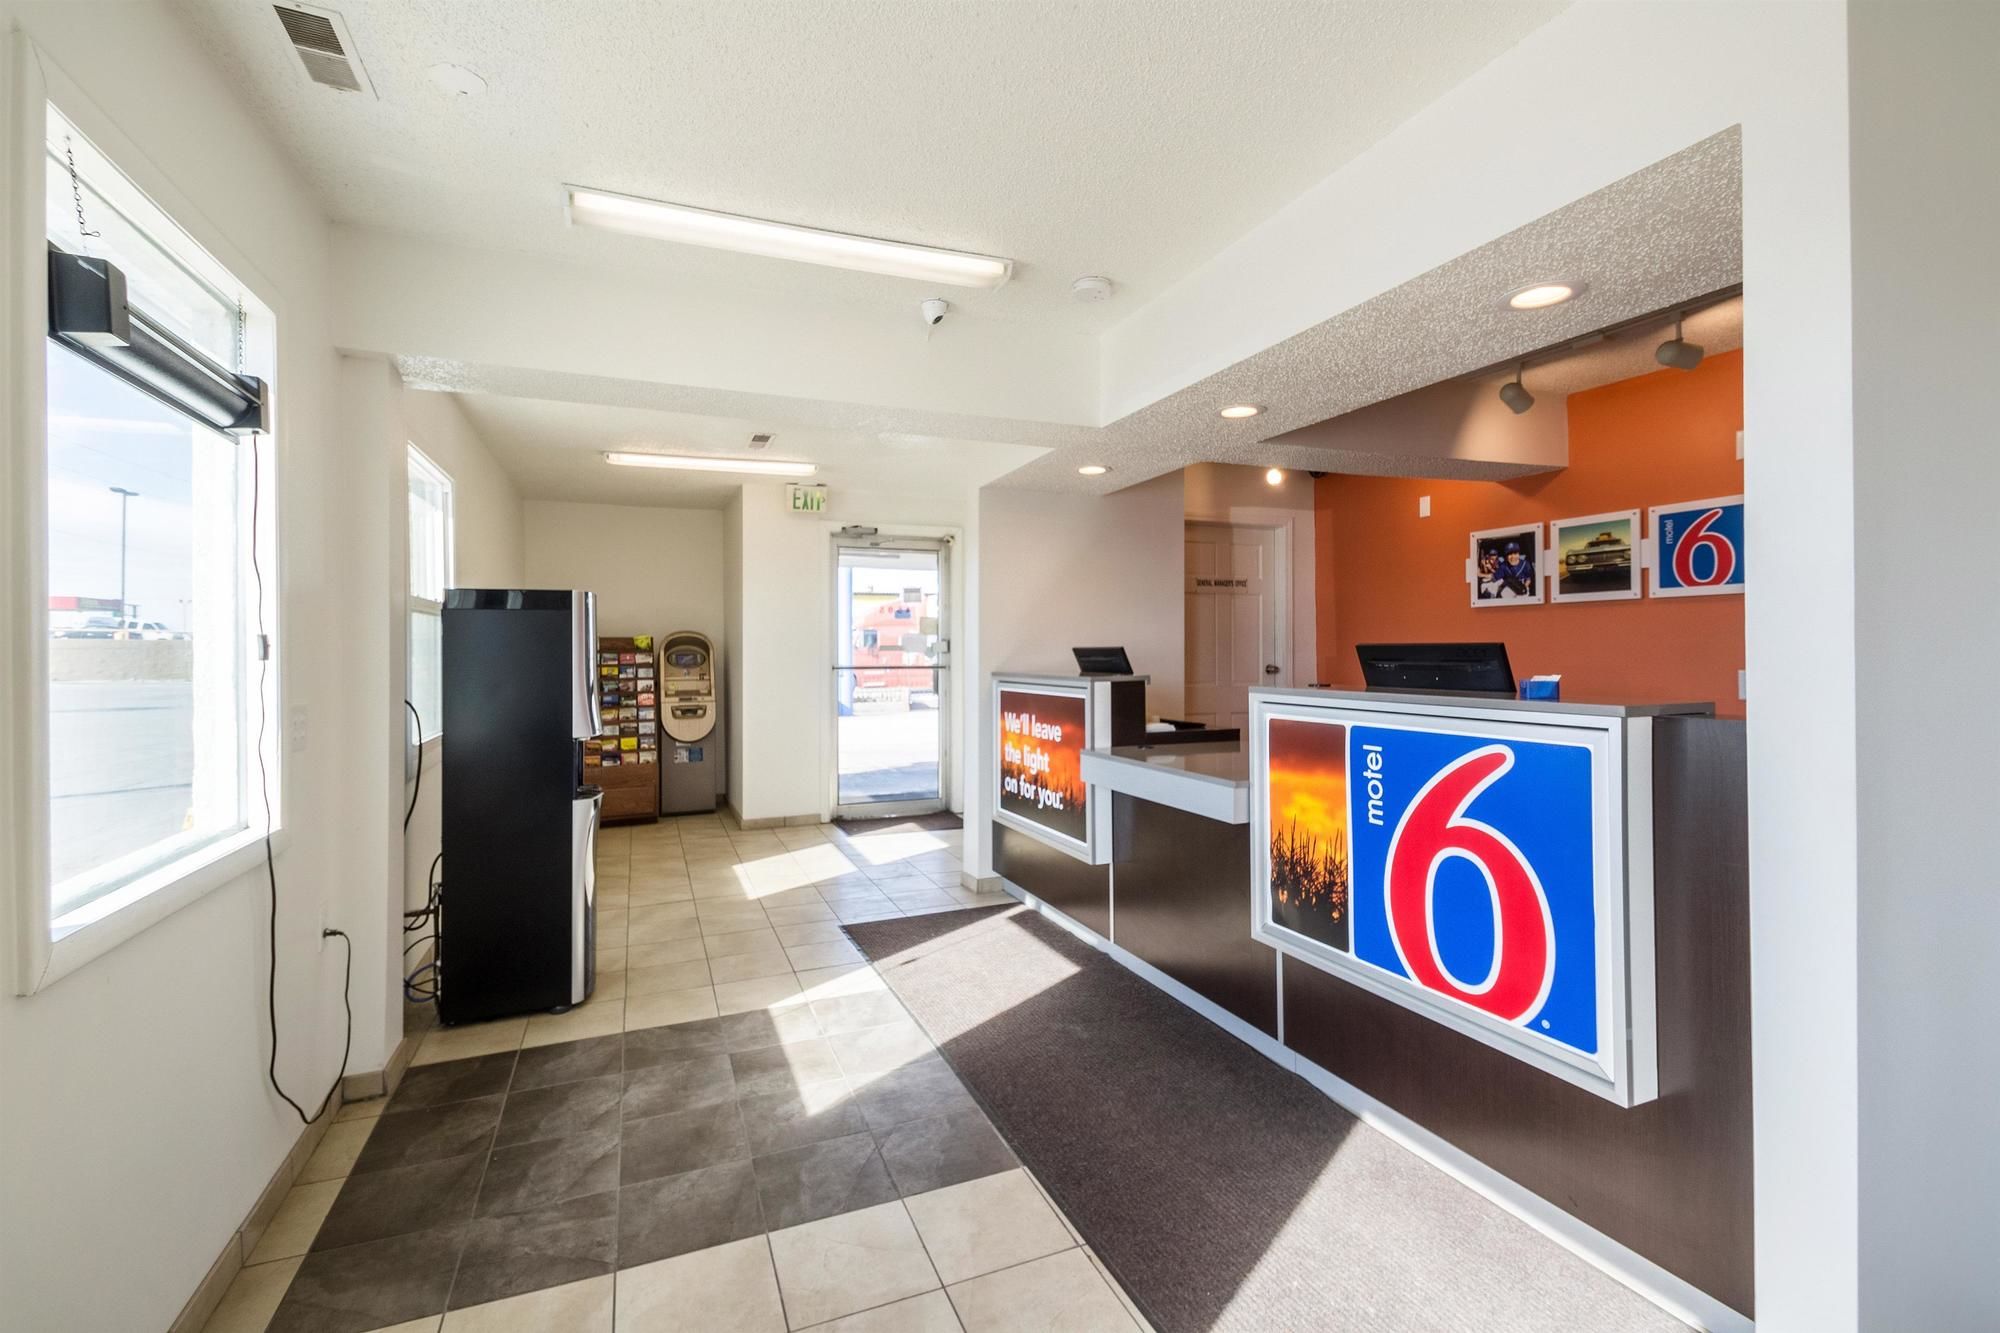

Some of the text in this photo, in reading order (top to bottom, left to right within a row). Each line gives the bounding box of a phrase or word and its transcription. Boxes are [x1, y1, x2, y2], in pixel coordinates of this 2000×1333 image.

[792, 488, 822, 511] EXIT
[1664, 508, 1736, 587] motel 6
[1004, 711, 1062, 742] We'll leave
[1004, 742, 1050, 774] the light
[1004, 776, 1018, 794] on
[1019, 774, 1039, 800] for
[1362, 743, 1556, 1027] motel 6
